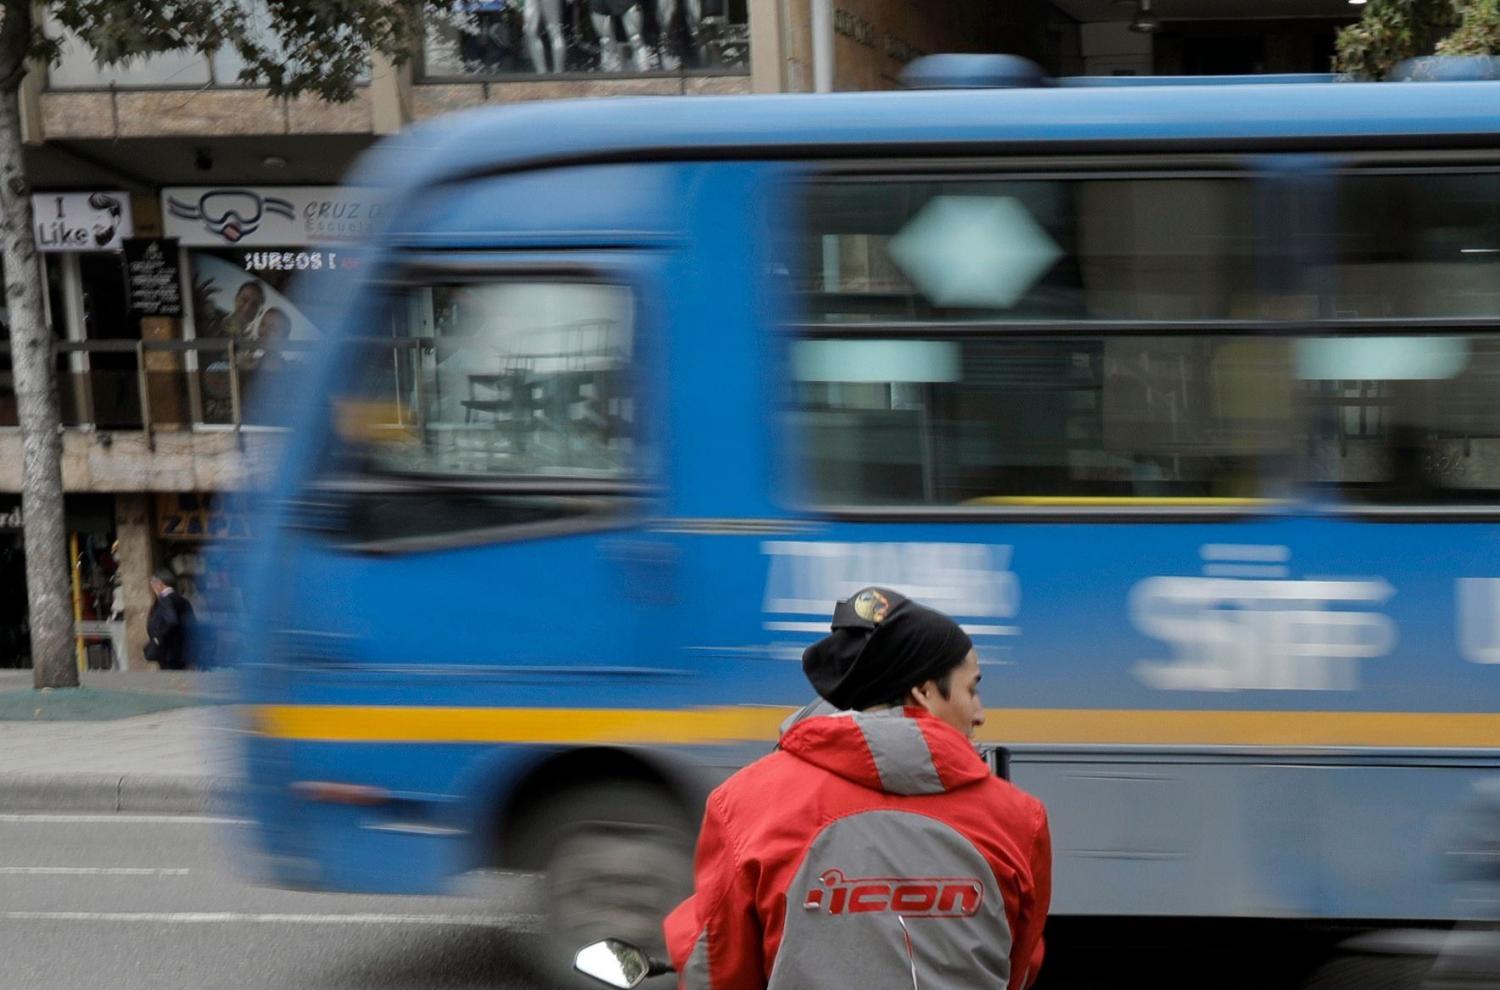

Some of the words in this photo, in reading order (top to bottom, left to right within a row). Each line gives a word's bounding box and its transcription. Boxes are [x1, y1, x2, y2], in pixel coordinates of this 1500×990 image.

[54, 197, 65, 218] I
[303, 201, 361, 219] CRUZ
[38, 221, 89, 245] Like
